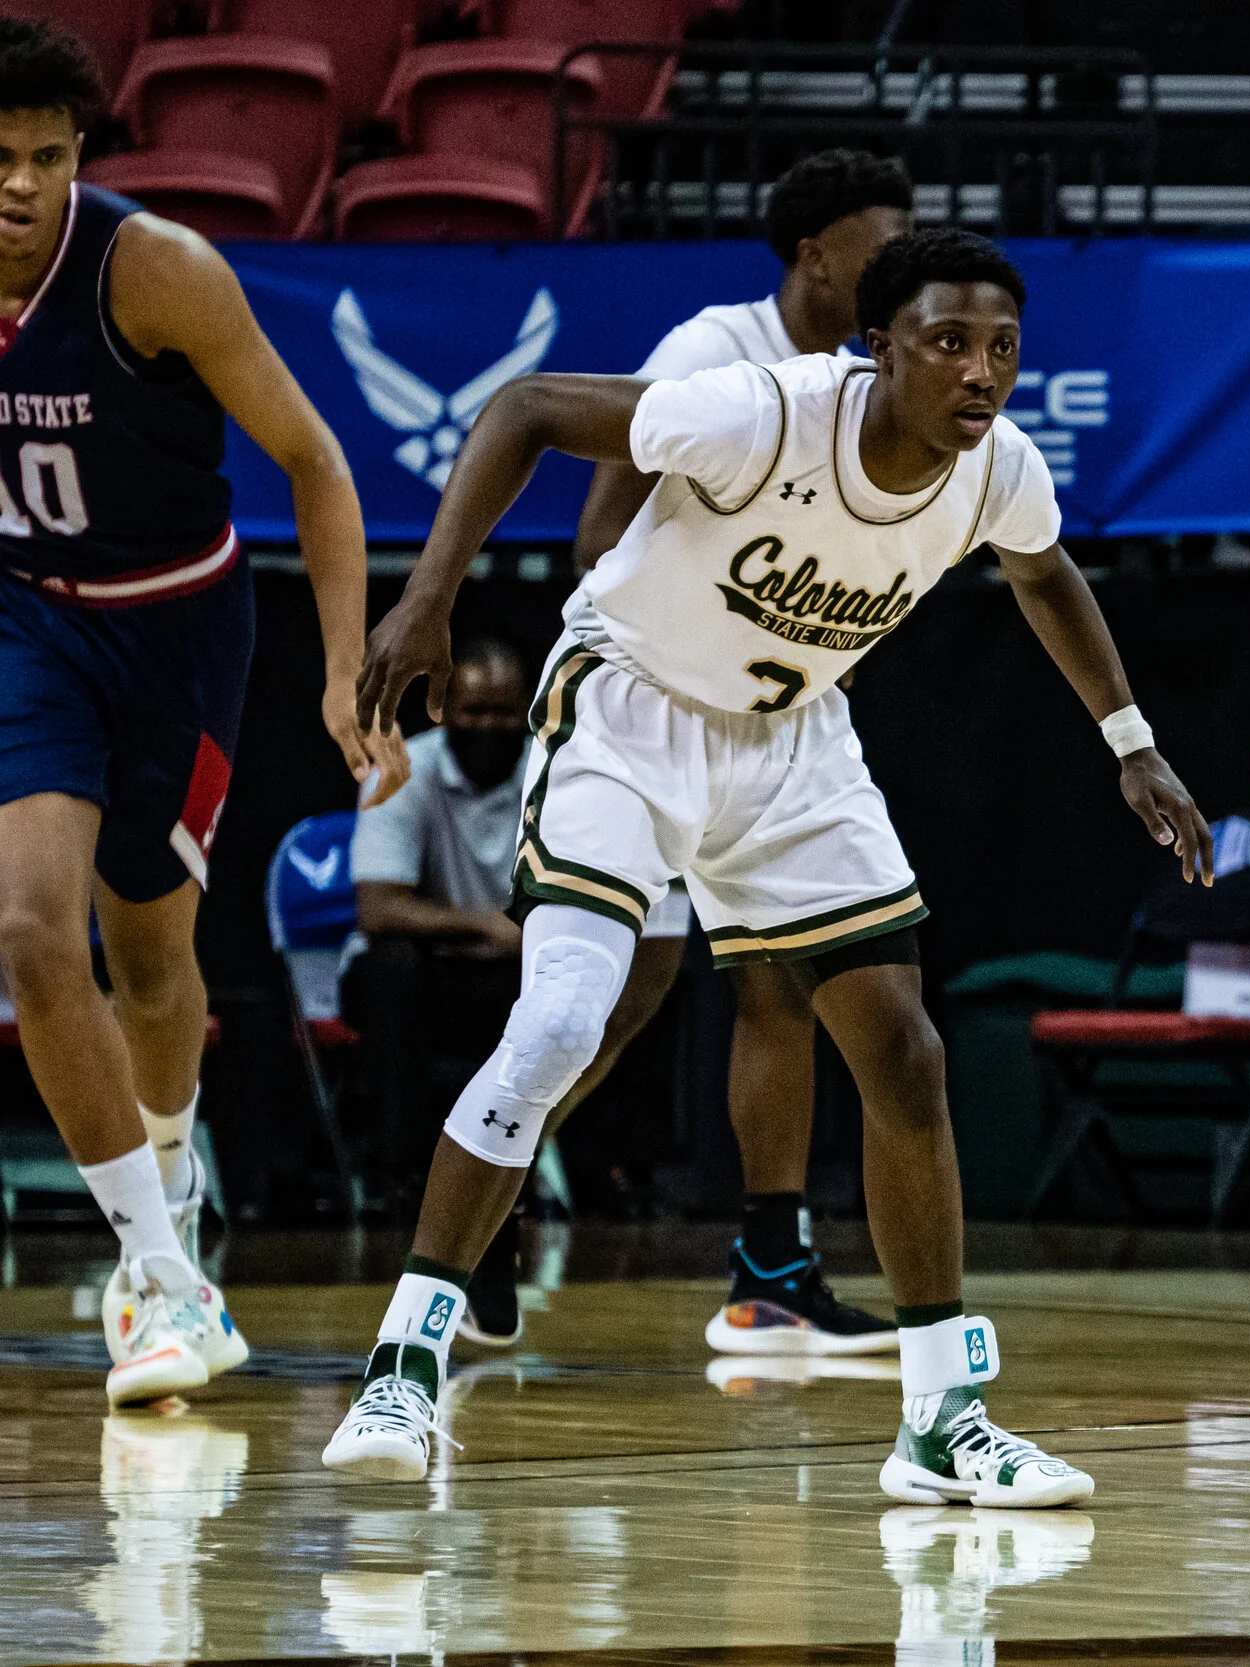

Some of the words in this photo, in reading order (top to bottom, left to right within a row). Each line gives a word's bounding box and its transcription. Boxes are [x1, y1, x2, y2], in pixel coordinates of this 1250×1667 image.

[14, 393, 93, 428] STATE
[729, 534, 914, 629] Colorado
[757, 612, 816, 644] STATE
[818, 629, 864, 650] UNIV
